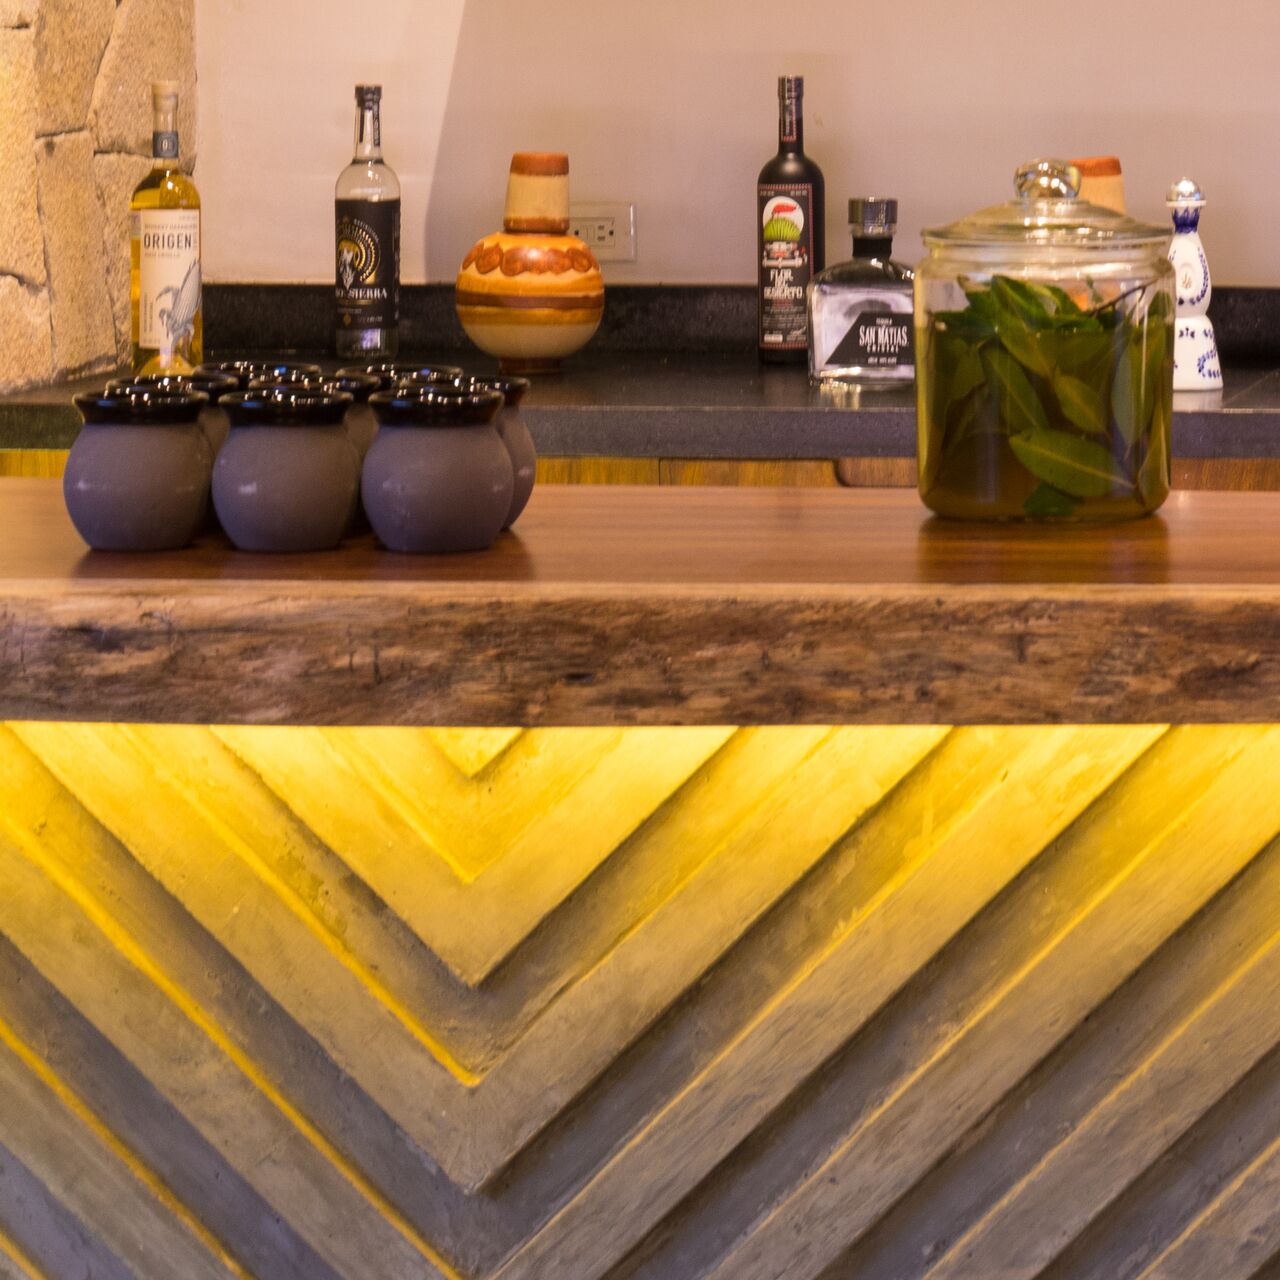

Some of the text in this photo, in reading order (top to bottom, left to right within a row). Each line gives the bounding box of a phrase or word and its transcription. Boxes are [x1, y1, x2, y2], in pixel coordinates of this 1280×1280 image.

[143, 233, 192, 249] ORIGEN
[770, 269, 794, 282] FLOR
[859, 325, 876, 347] SAN
[866, 343, 899, 353] CRISTAL
